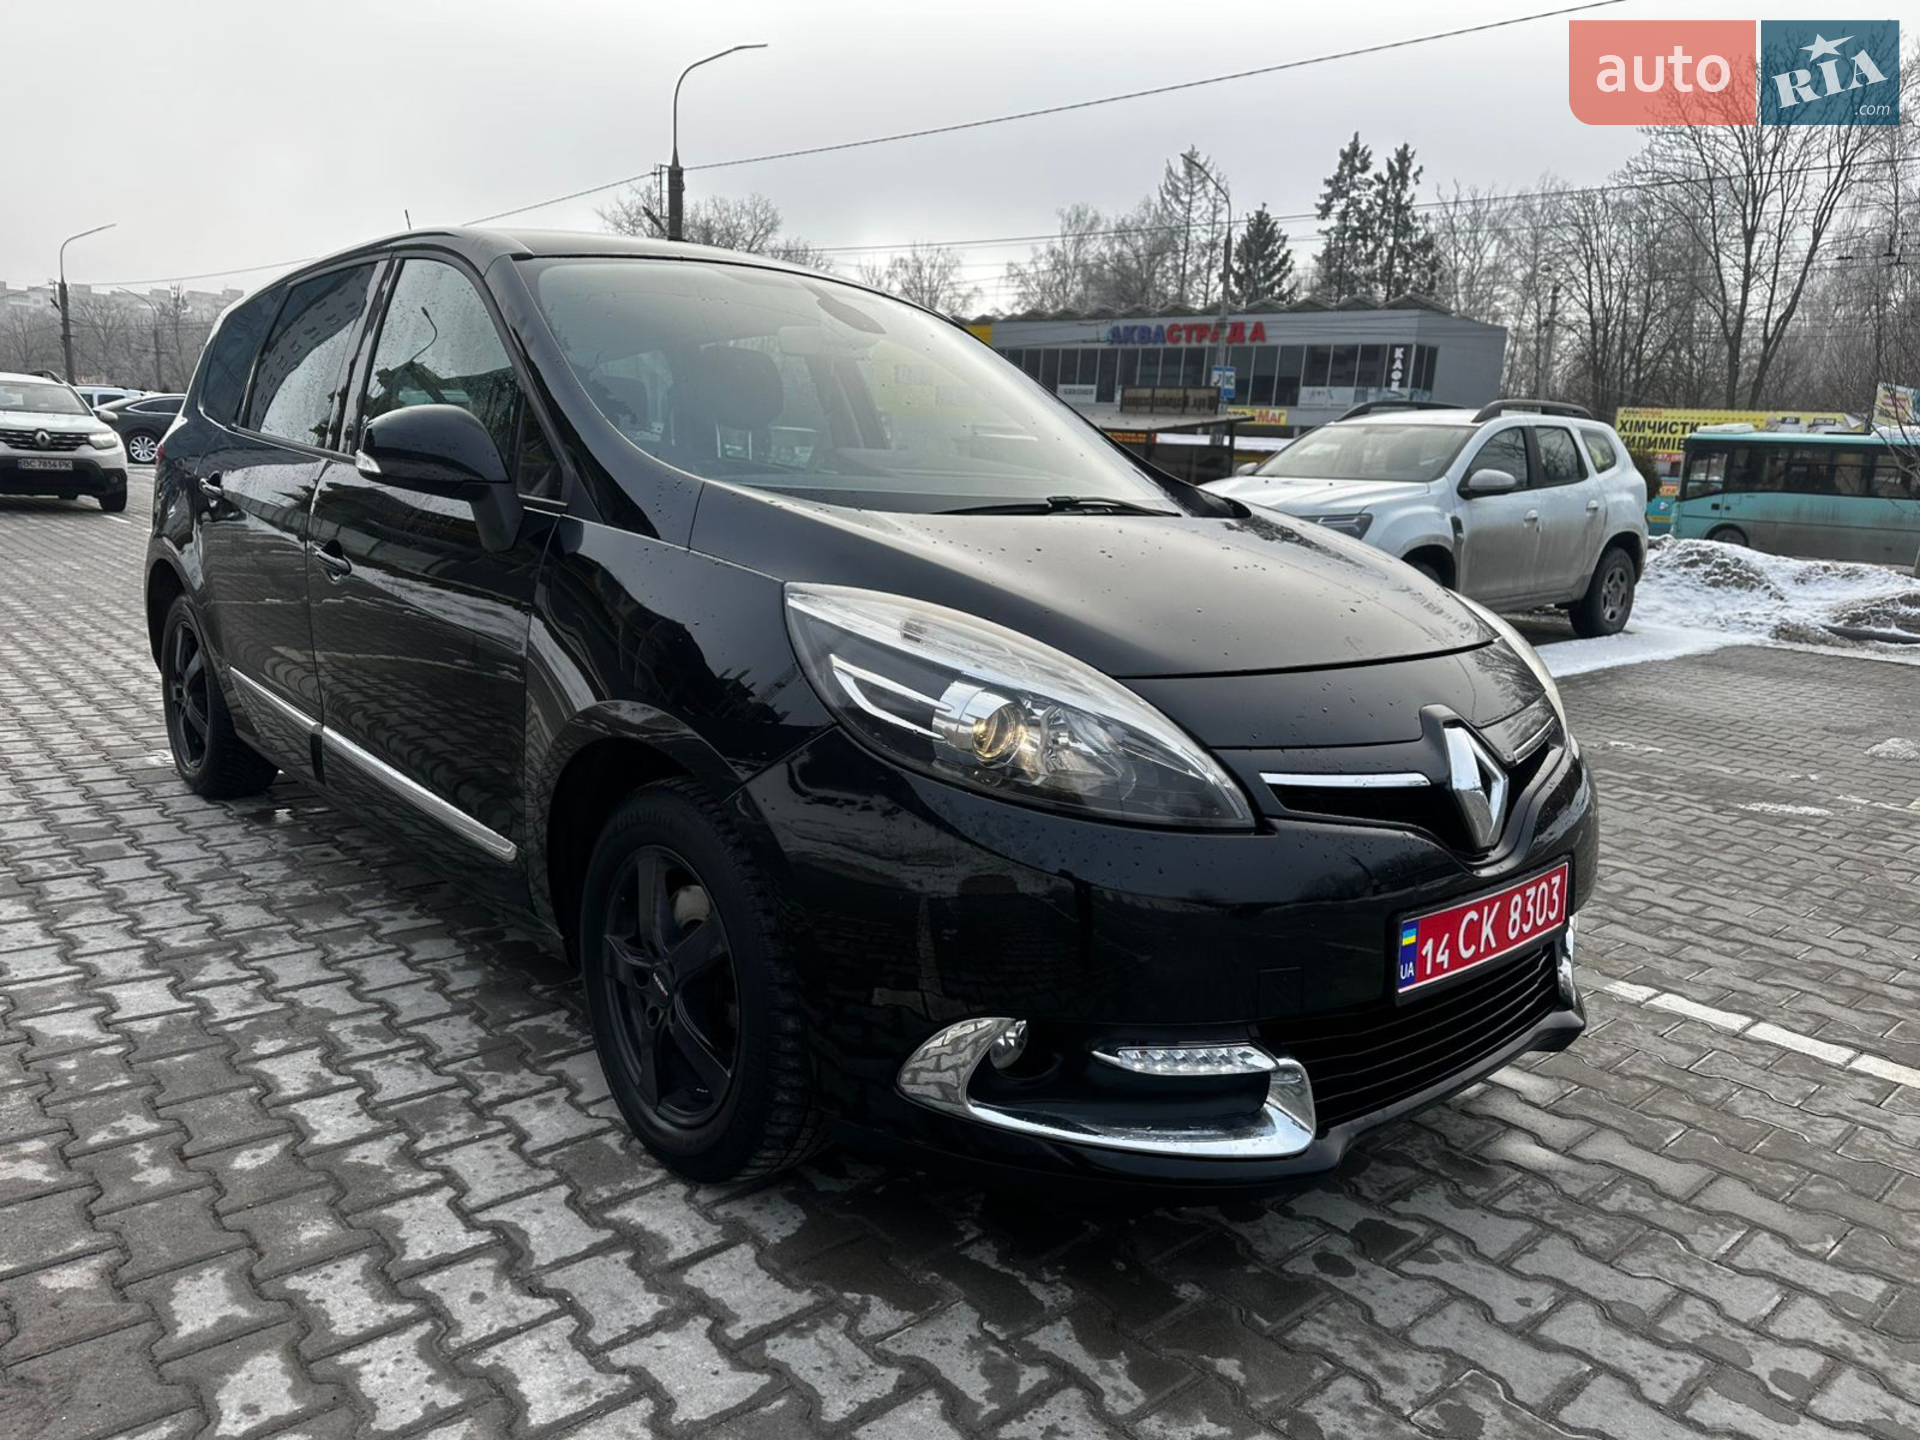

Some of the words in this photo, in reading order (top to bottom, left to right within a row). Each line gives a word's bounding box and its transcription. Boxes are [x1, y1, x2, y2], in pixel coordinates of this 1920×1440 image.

[1619, 420, 1707, 434] ХІМЧИСТК
[1421, 933, 1450, 975] 14
[1458, 901, 1501, 959] CK
[1508, 874, 1561, 940] 8303
[1400, 963, 1415, 980] UA
